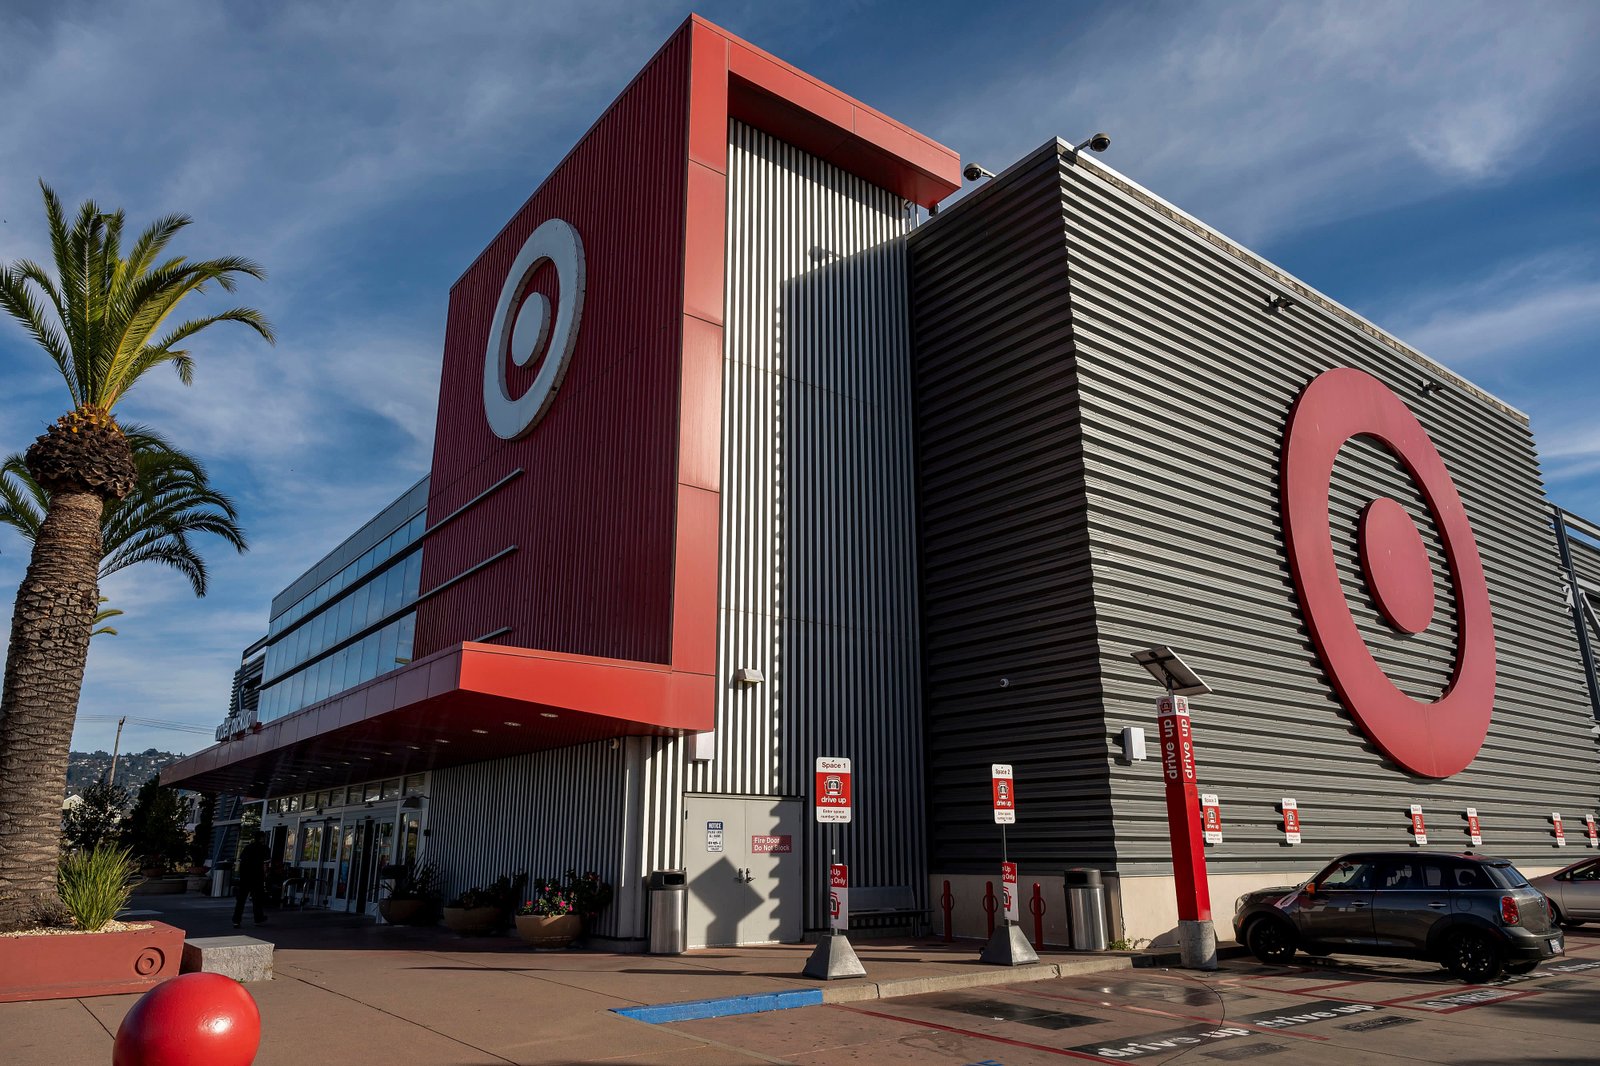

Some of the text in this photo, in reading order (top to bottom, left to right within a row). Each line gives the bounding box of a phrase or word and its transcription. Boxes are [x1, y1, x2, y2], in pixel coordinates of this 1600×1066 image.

[1164, 720, 1178, 779] drive up
[1181, 719, 1193, 779] drive up
[821, 761, 841, 770] Space
[834, 877, 846, 885] Only
[1253, 1010, 1337, 1028] drive
[1331, 1004, 1375, 1013] up
[1098, 1036, 1201, 1058] drive
[1199, 1027, 1250, 1038] up
